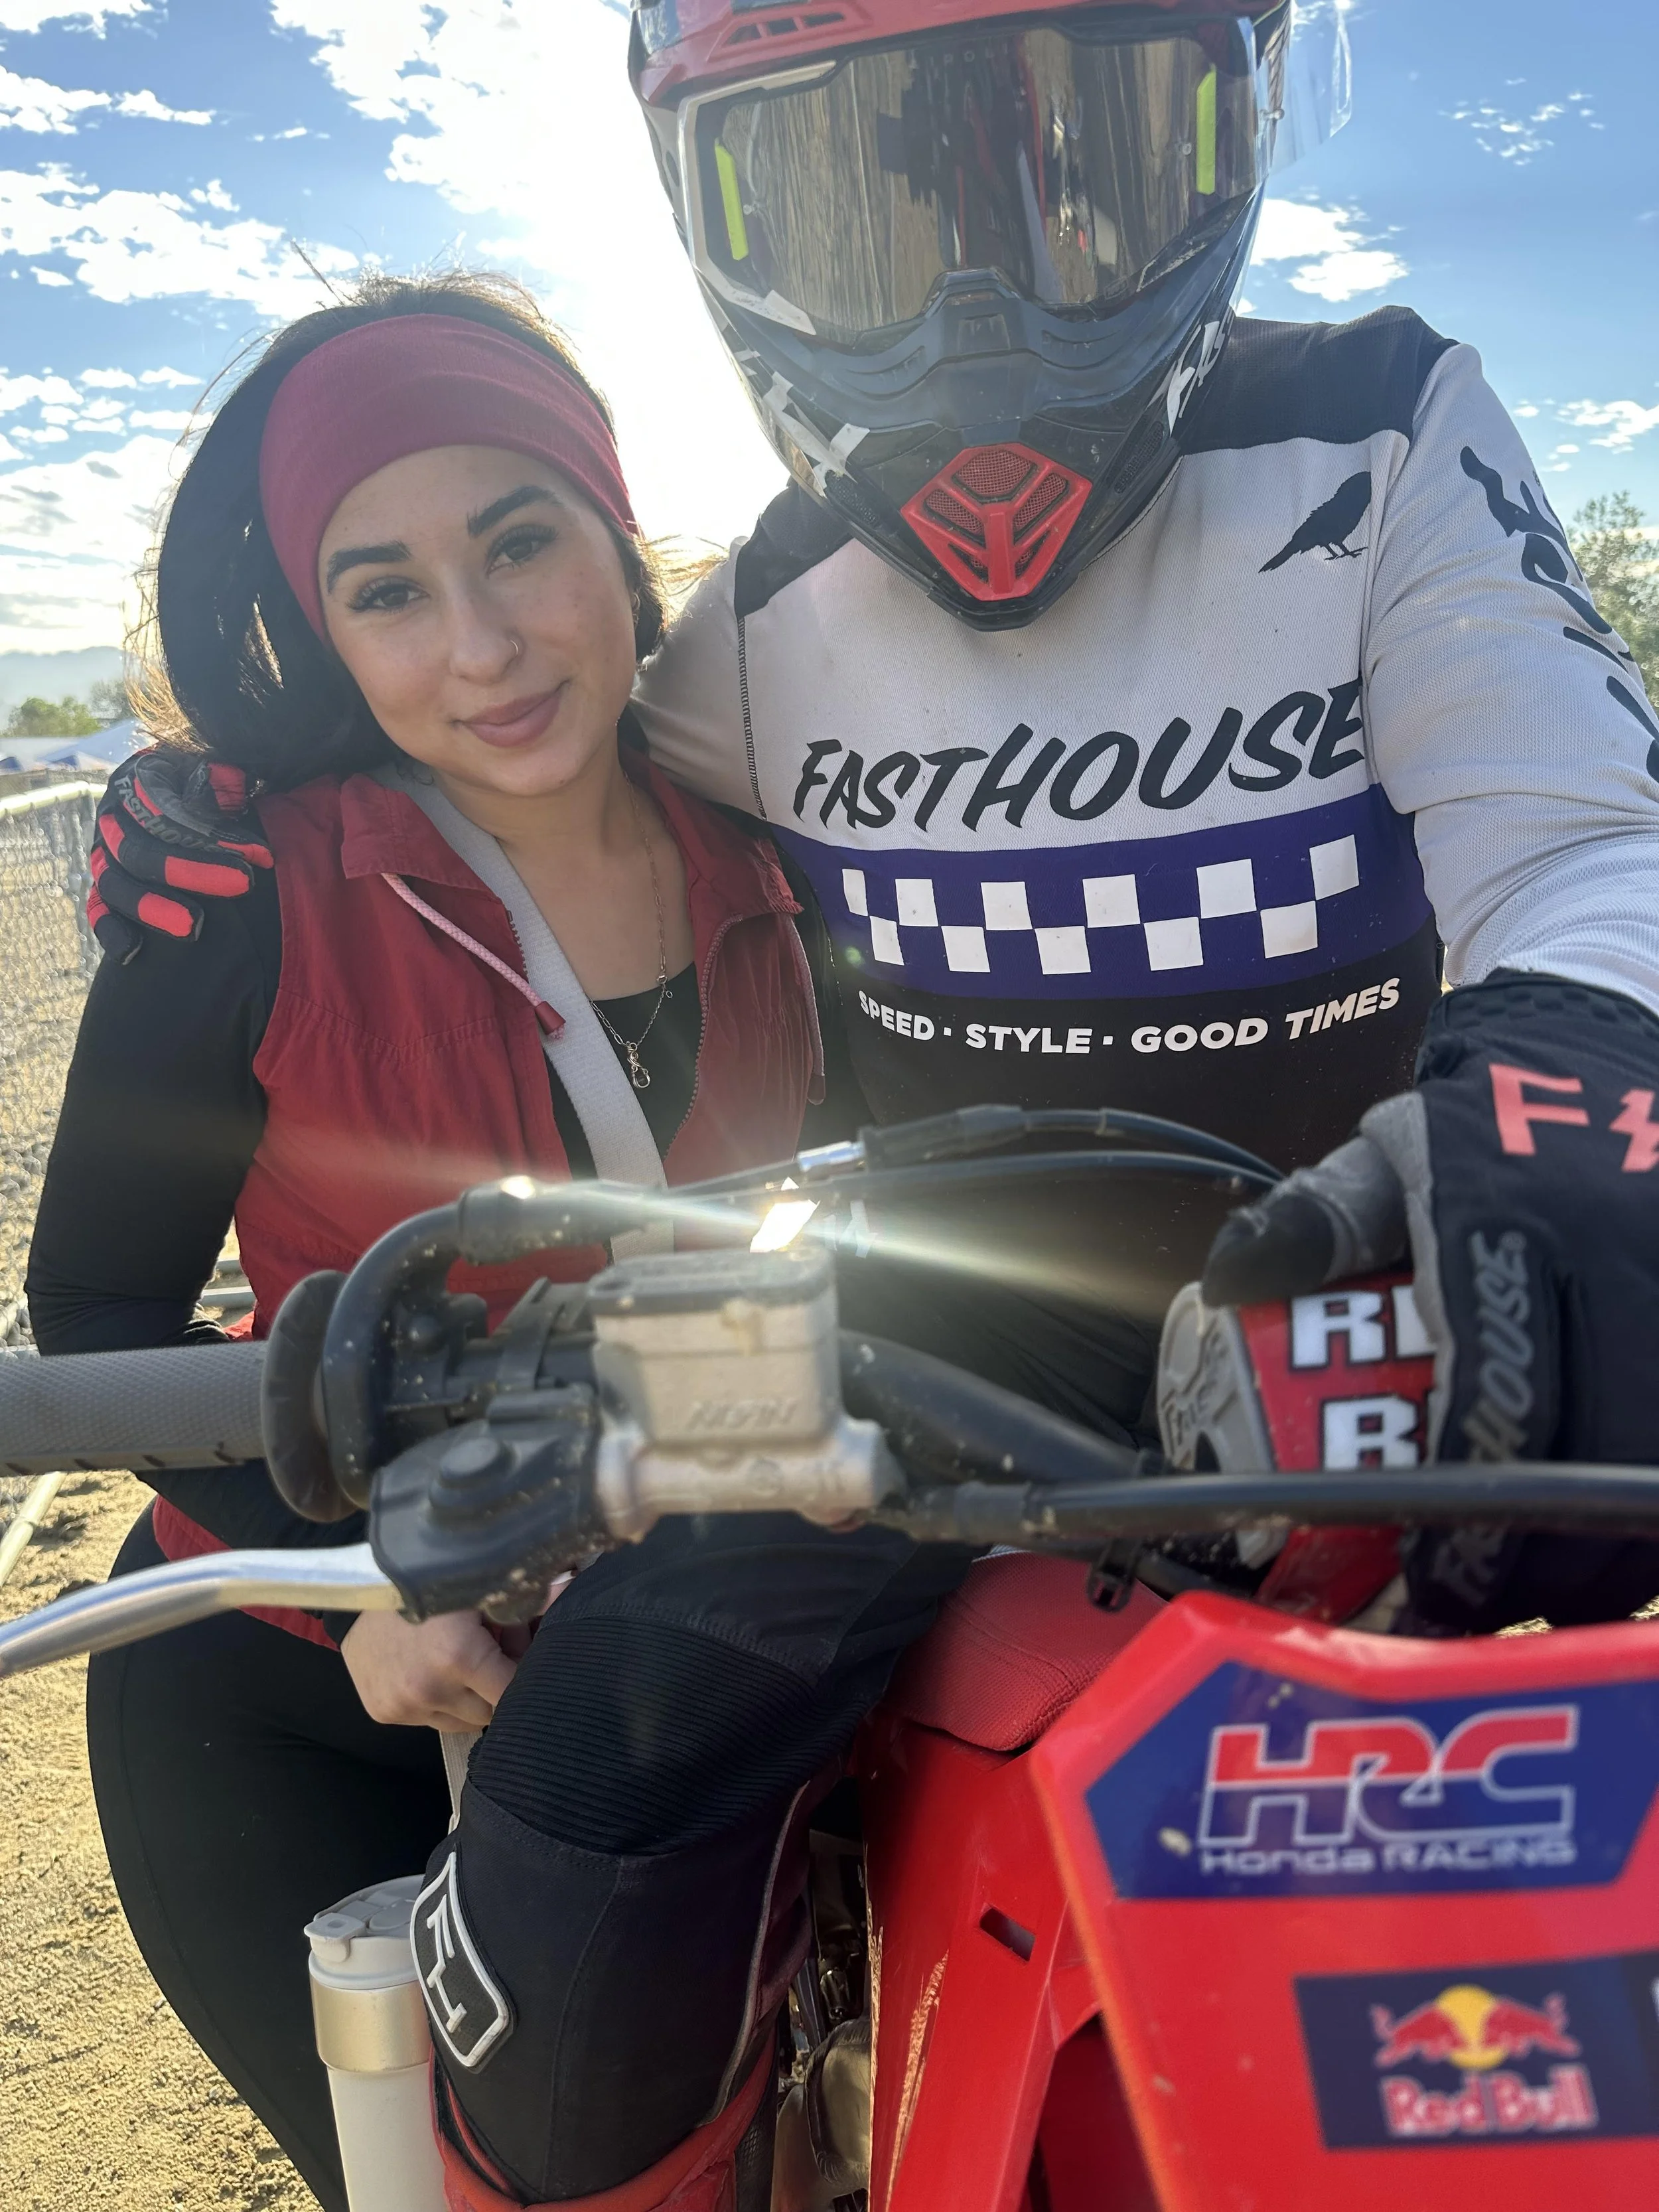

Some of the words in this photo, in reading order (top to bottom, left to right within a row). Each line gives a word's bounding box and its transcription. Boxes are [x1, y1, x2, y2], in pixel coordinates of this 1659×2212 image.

[794, 678, 1365, 832] FASTHOUSE
[859, 990, 936, 1041] SPEED
[966, 1023, 1094, 1054] STYLE
[1131, 1017, 1269, 1053] GOOD
[1285, 977, 1401, 1040] TIMES
[1197, 1704, 1579, 1847] HRC
[1383, 1838, 1577, 1873] RACING
[1378, 2067, 1486, 2137] Red
[1490, 2061, 1601, 2134] Bull
